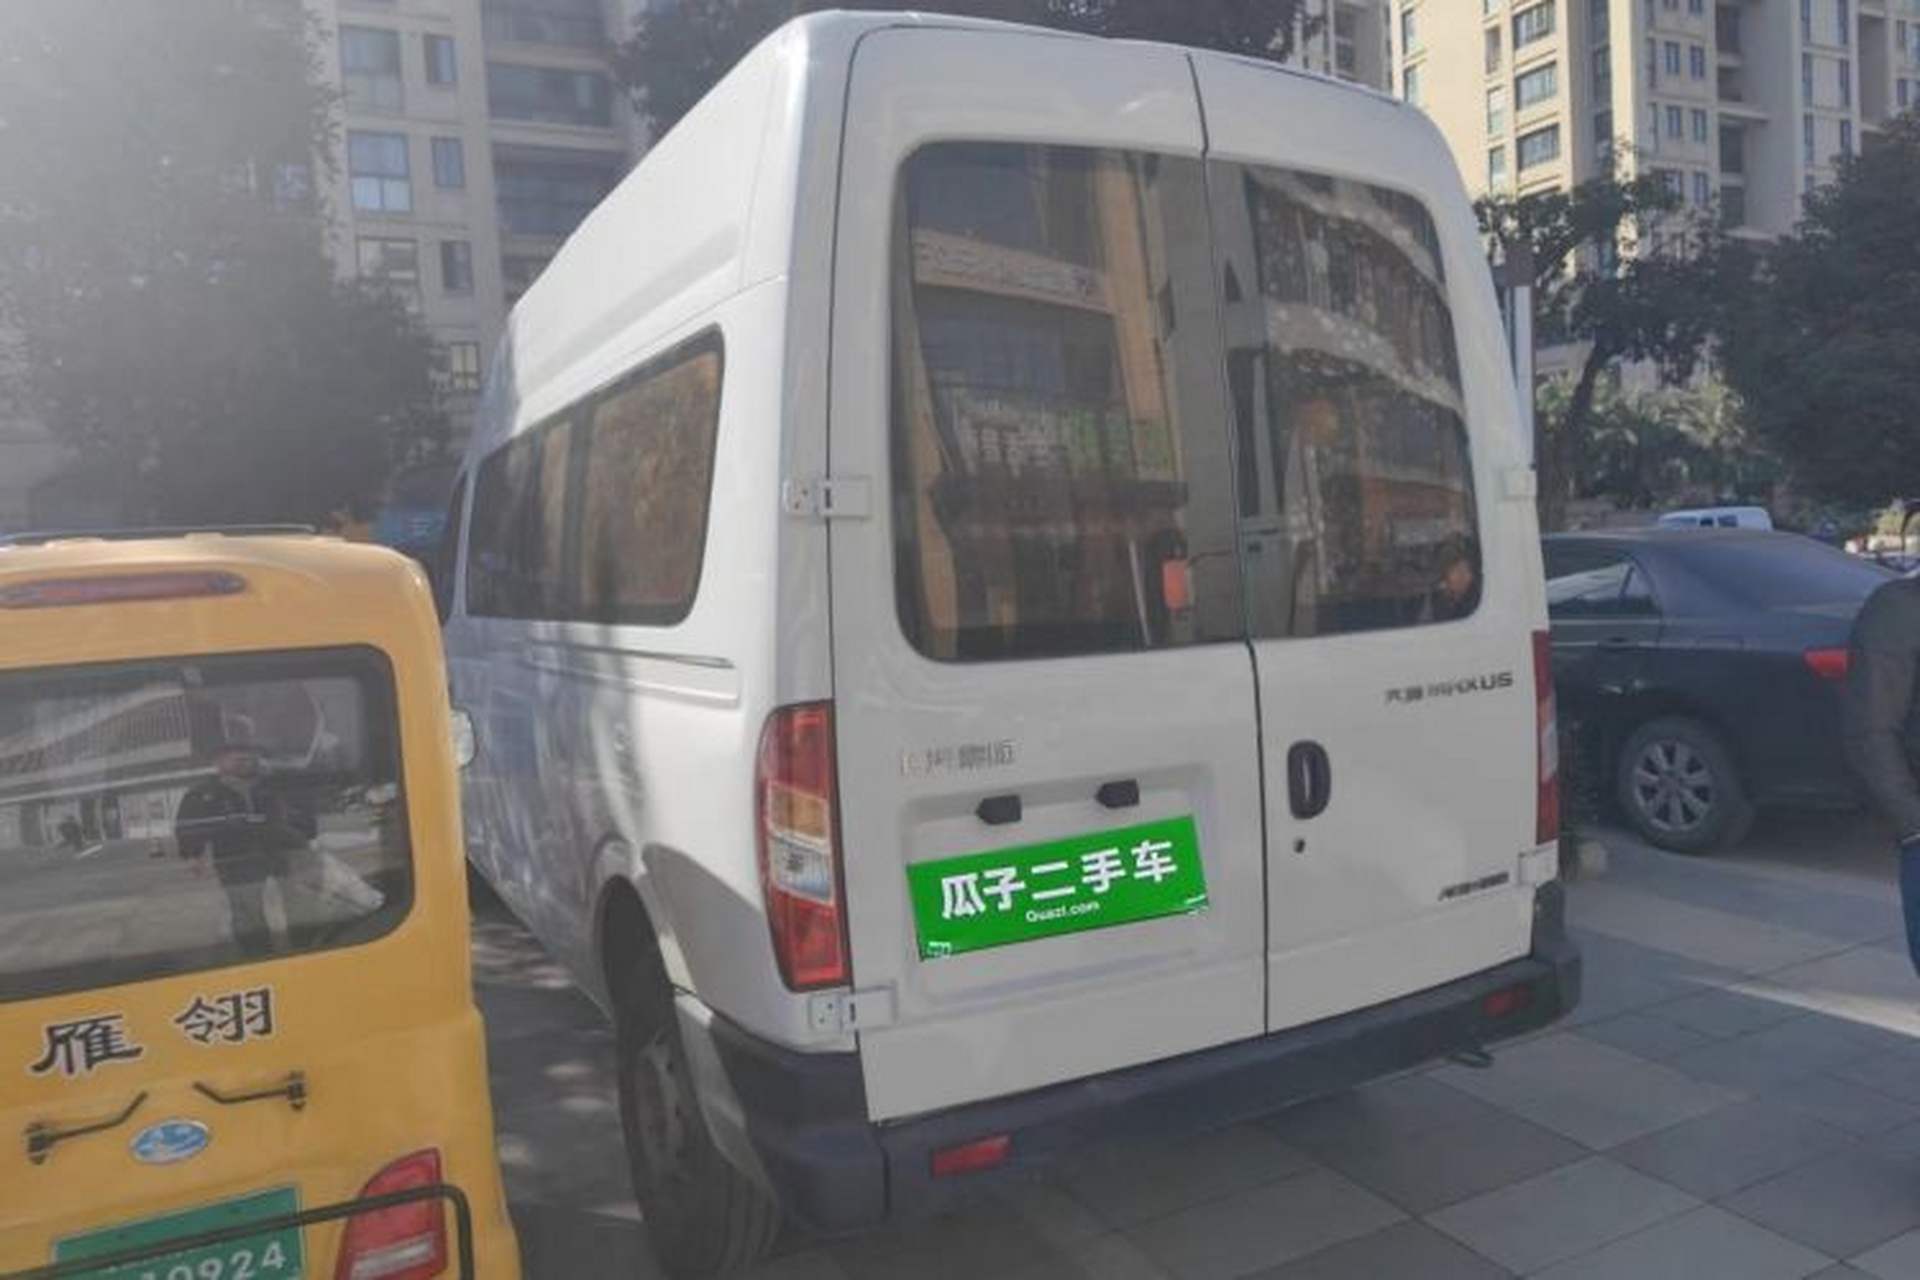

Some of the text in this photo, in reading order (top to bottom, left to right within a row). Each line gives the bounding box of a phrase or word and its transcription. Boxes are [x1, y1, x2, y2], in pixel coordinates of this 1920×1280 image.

[941, 840, 1178, 919] 瓜子二手车
[142, 1240, 286, 1280] 0924
